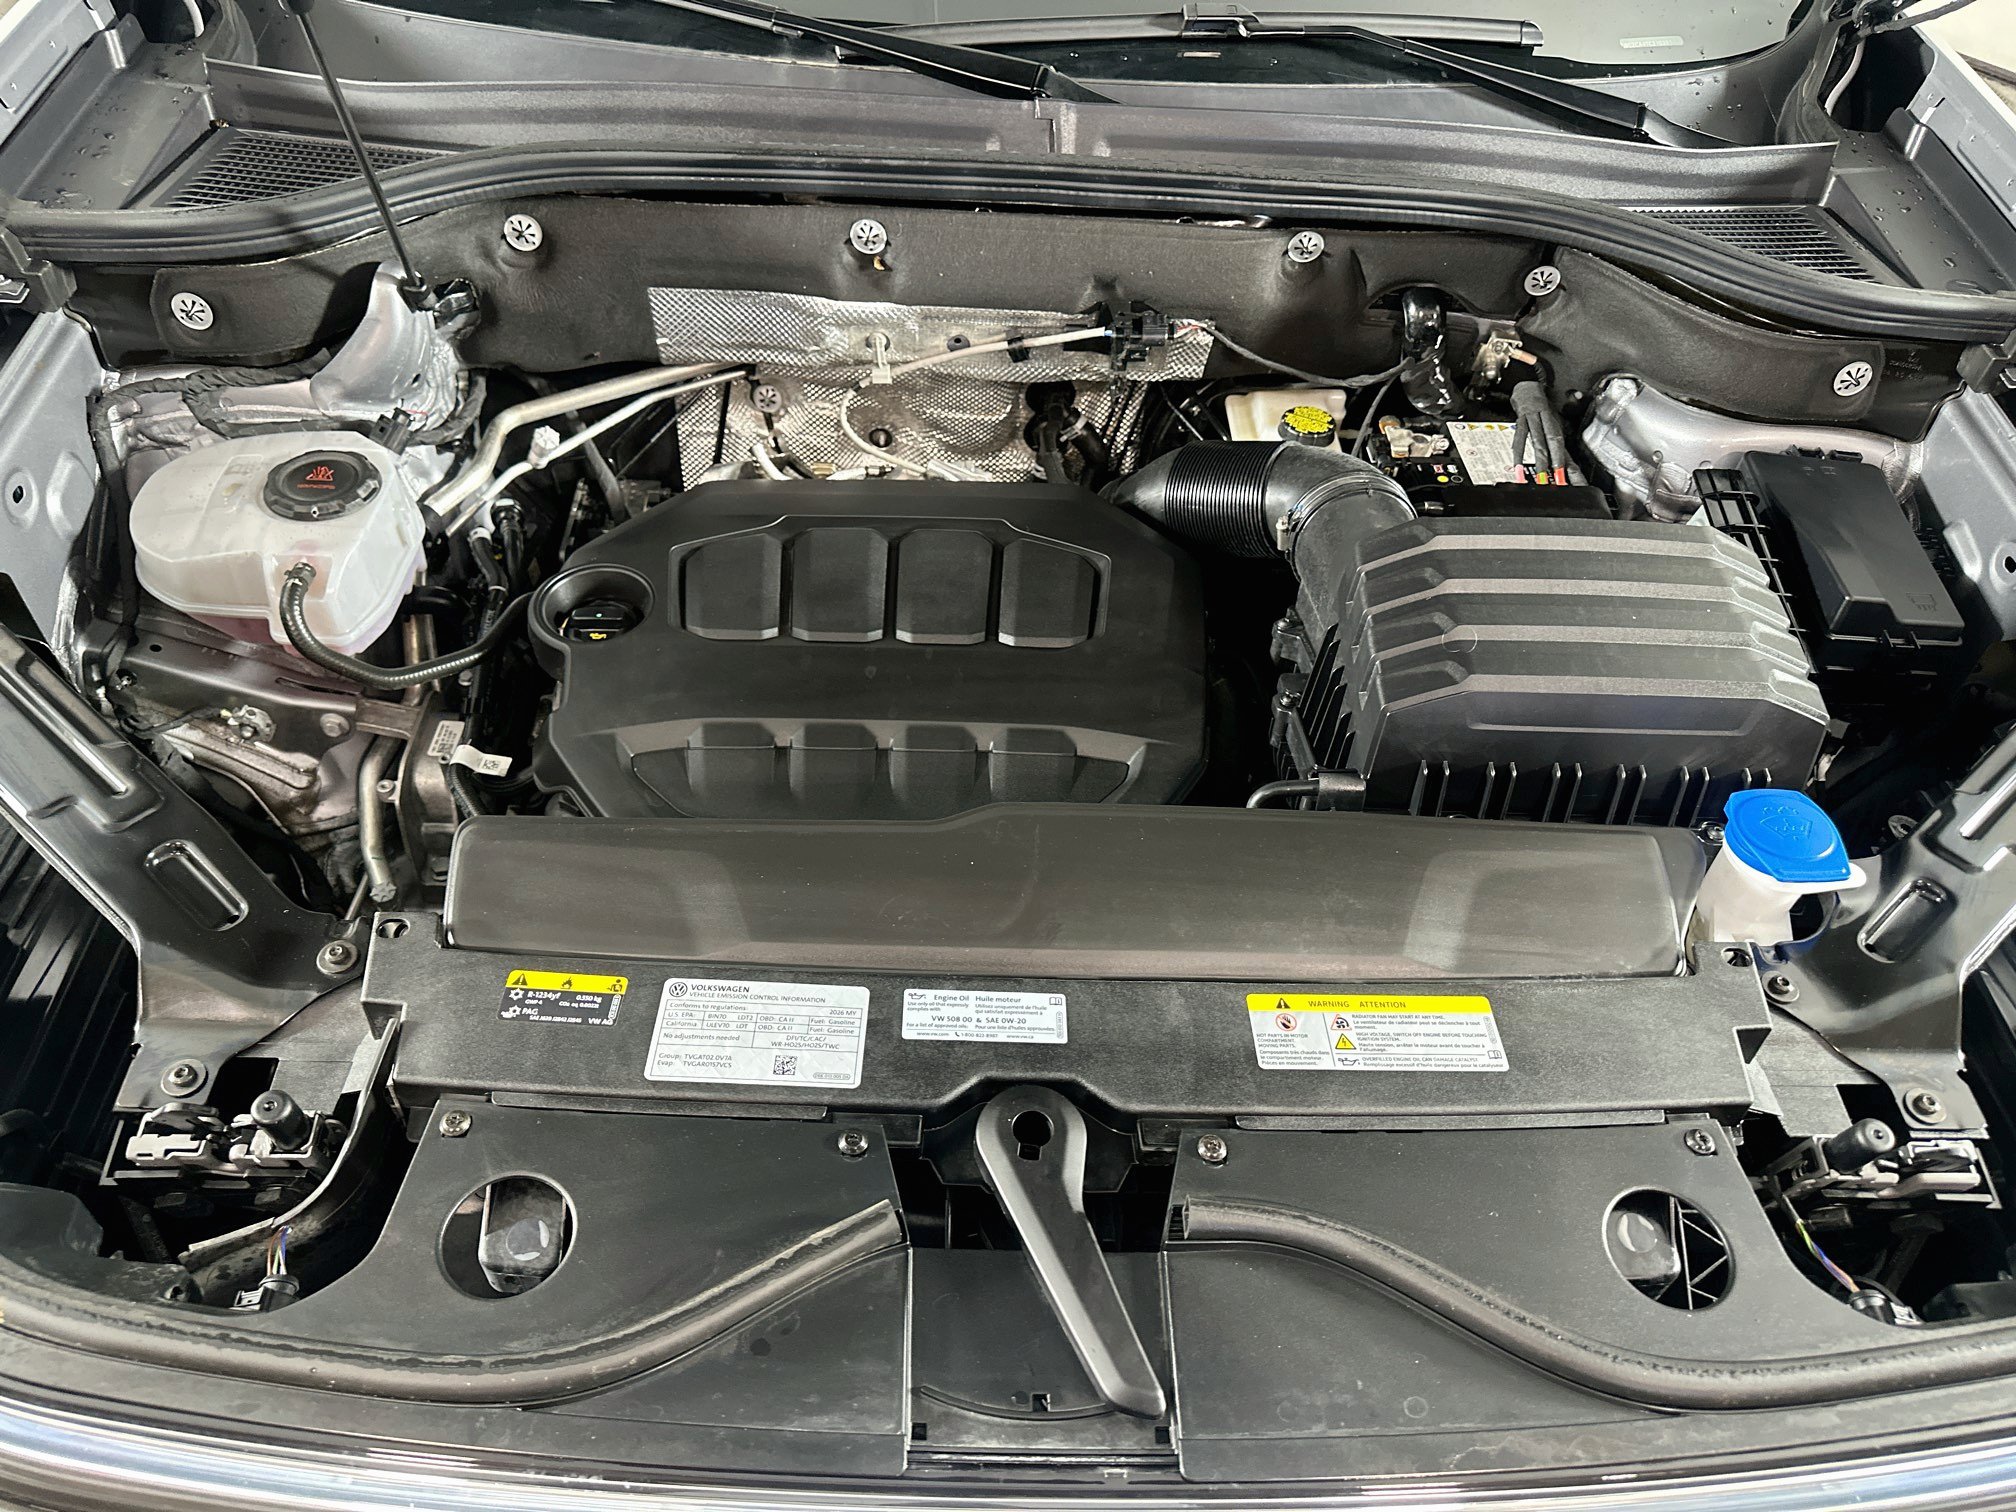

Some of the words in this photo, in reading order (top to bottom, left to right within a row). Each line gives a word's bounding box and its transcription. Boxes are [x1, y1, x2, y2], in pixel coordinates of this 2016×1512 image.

[691, 984, 750, 993] VOLKSWAGEN
[527, 991, 561, 1001] R-1234yf
[594, 995, 602, 1003] kg
[780, 995, 826, 1003] INFORMATION
[521, 1007, 539, 1015] PAG
